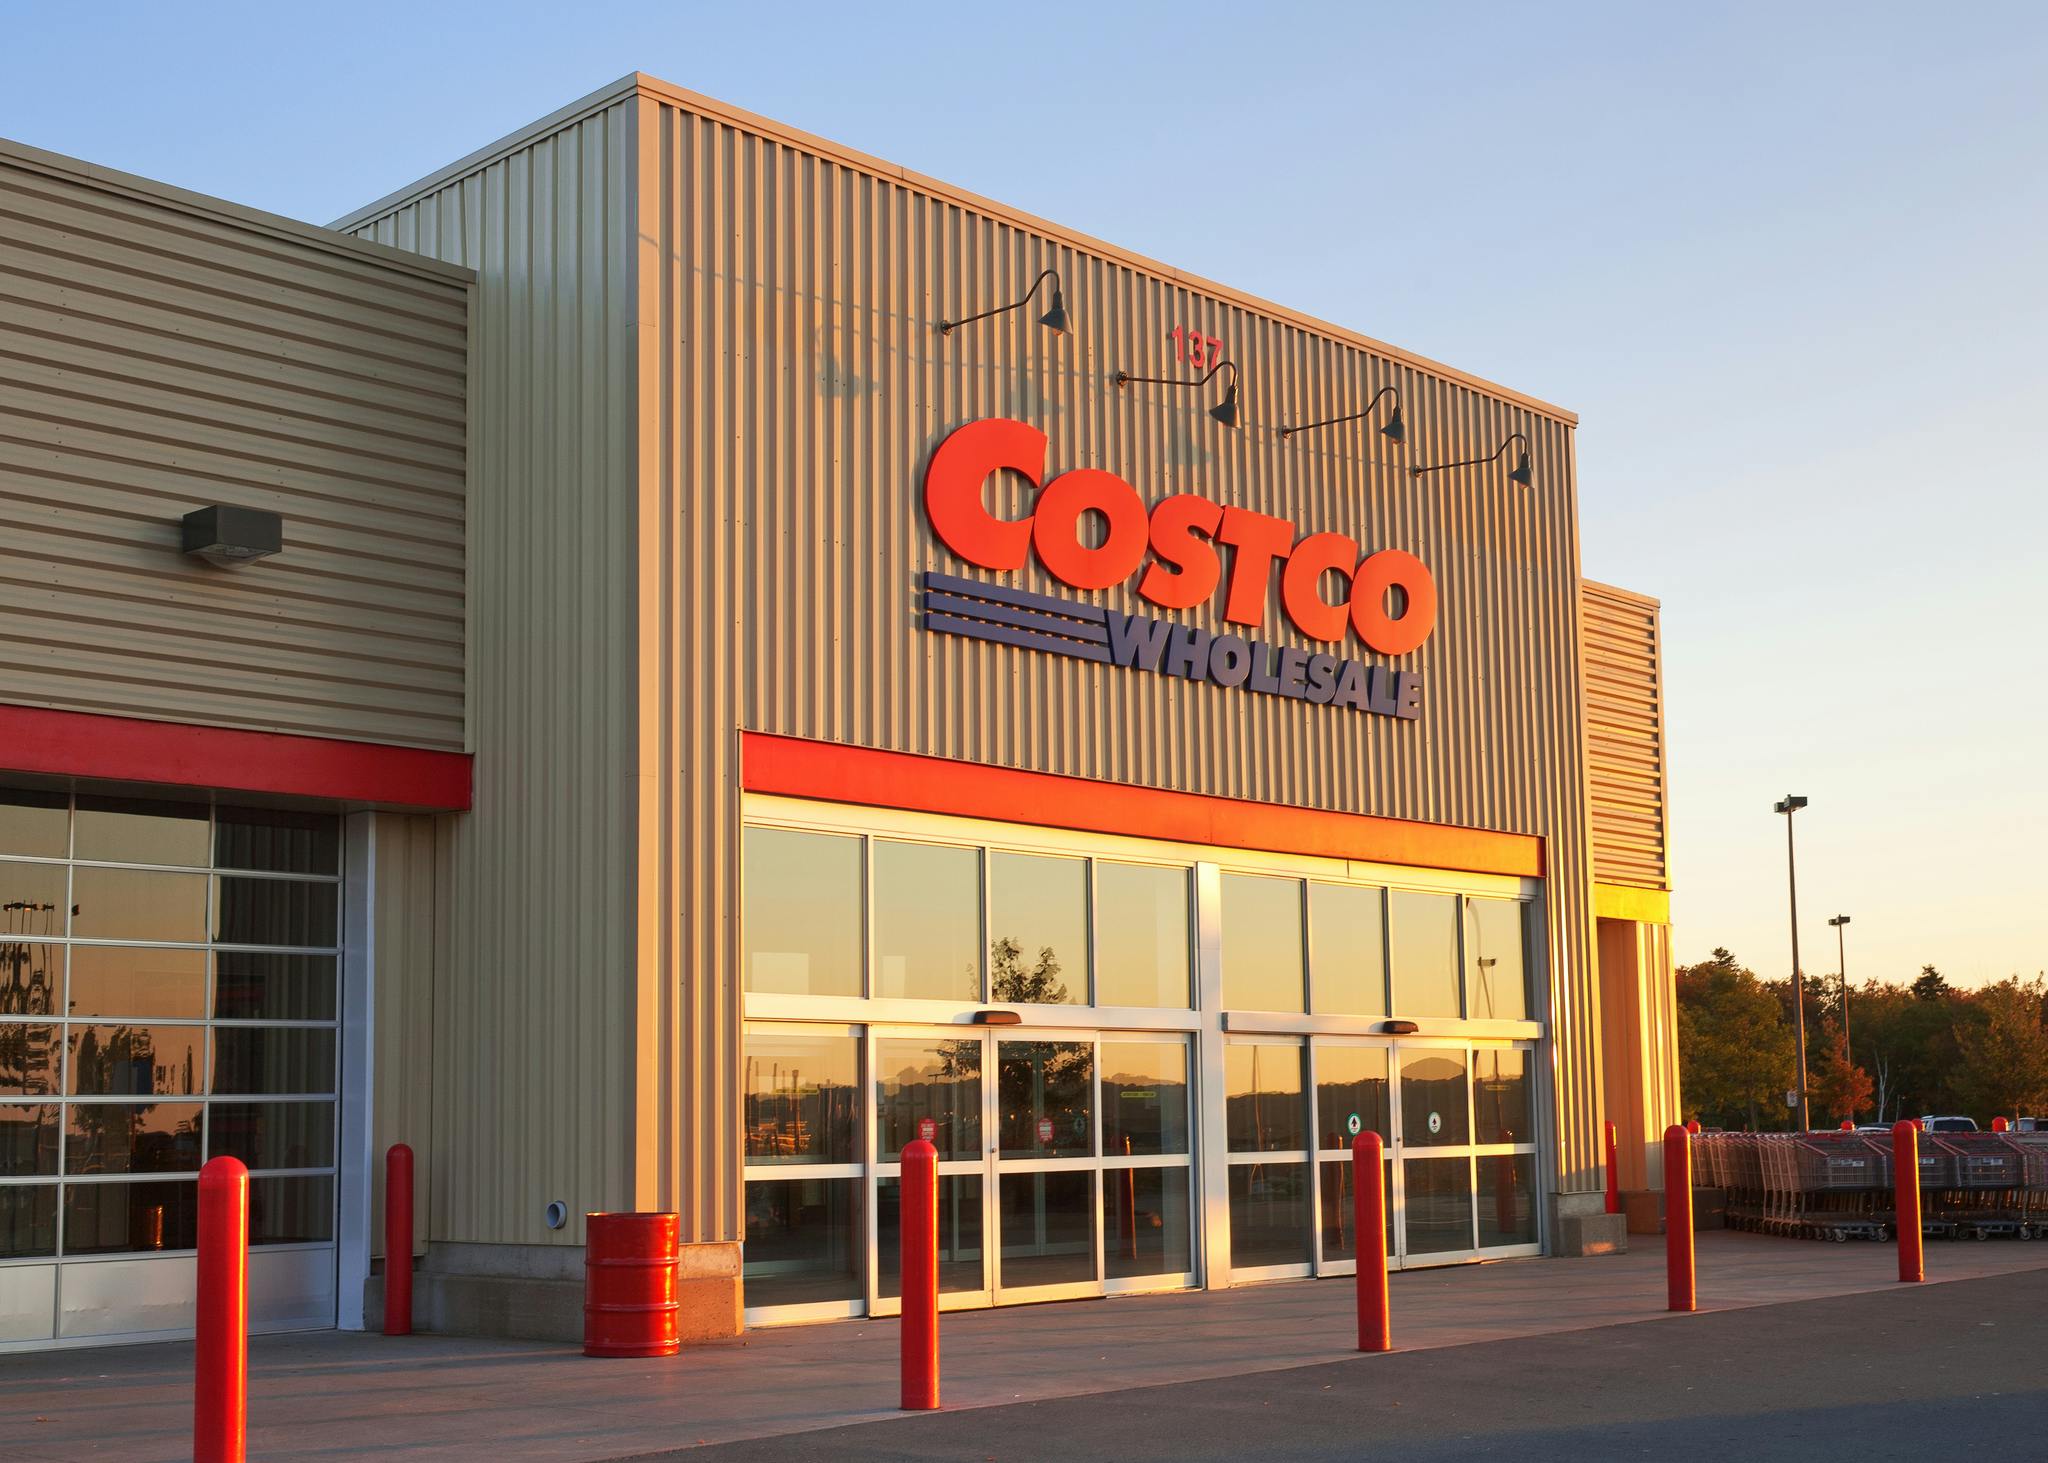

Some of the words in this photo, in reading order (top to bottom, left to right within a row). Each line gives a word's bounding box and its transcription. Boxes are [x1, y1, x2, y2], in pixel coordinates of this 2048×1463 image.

[1171, 325, 1224, 370] 137
[924, 418, 1437, 656] COSTCO
[1105, 609, 1422, 721] WHOLESALE
